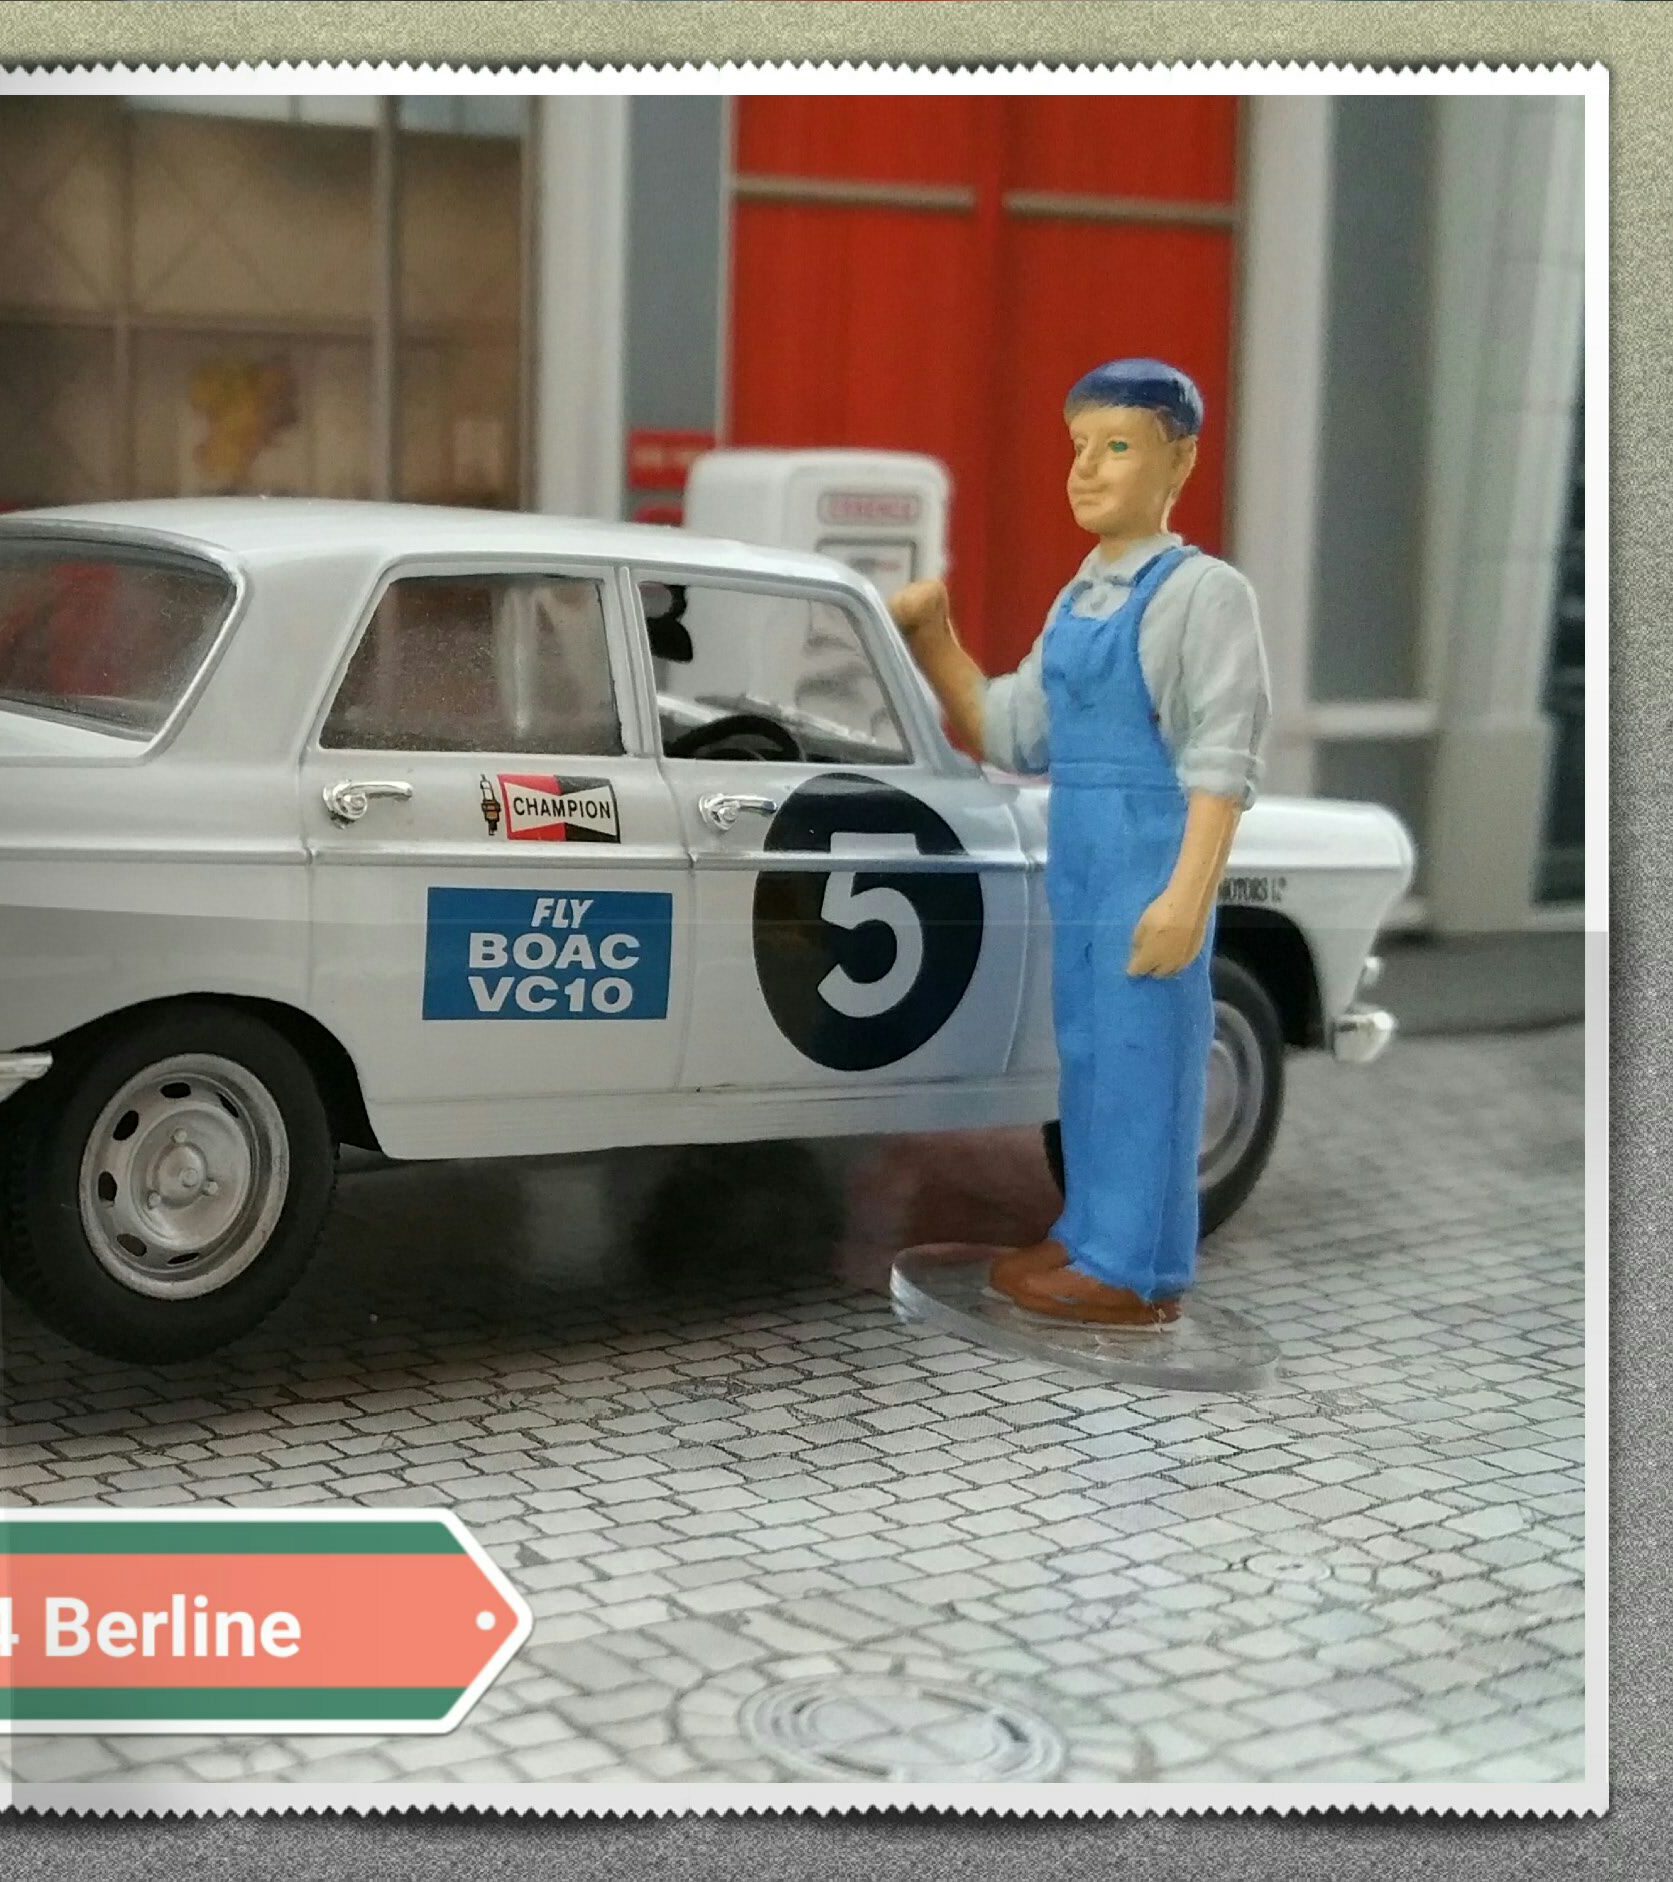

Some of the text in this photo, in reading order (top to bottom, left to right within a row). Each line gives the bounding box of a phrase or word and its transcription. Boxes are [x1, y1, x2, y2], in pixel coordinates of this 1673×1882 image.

[513, 796, 612, 819] CHAMPION
[531, 898, 595, 929] FLY
[817, 831, 923, 1019] 5
[469, 932, 641, 970] BOAC
[467, 975, 634, 1013] VC10
